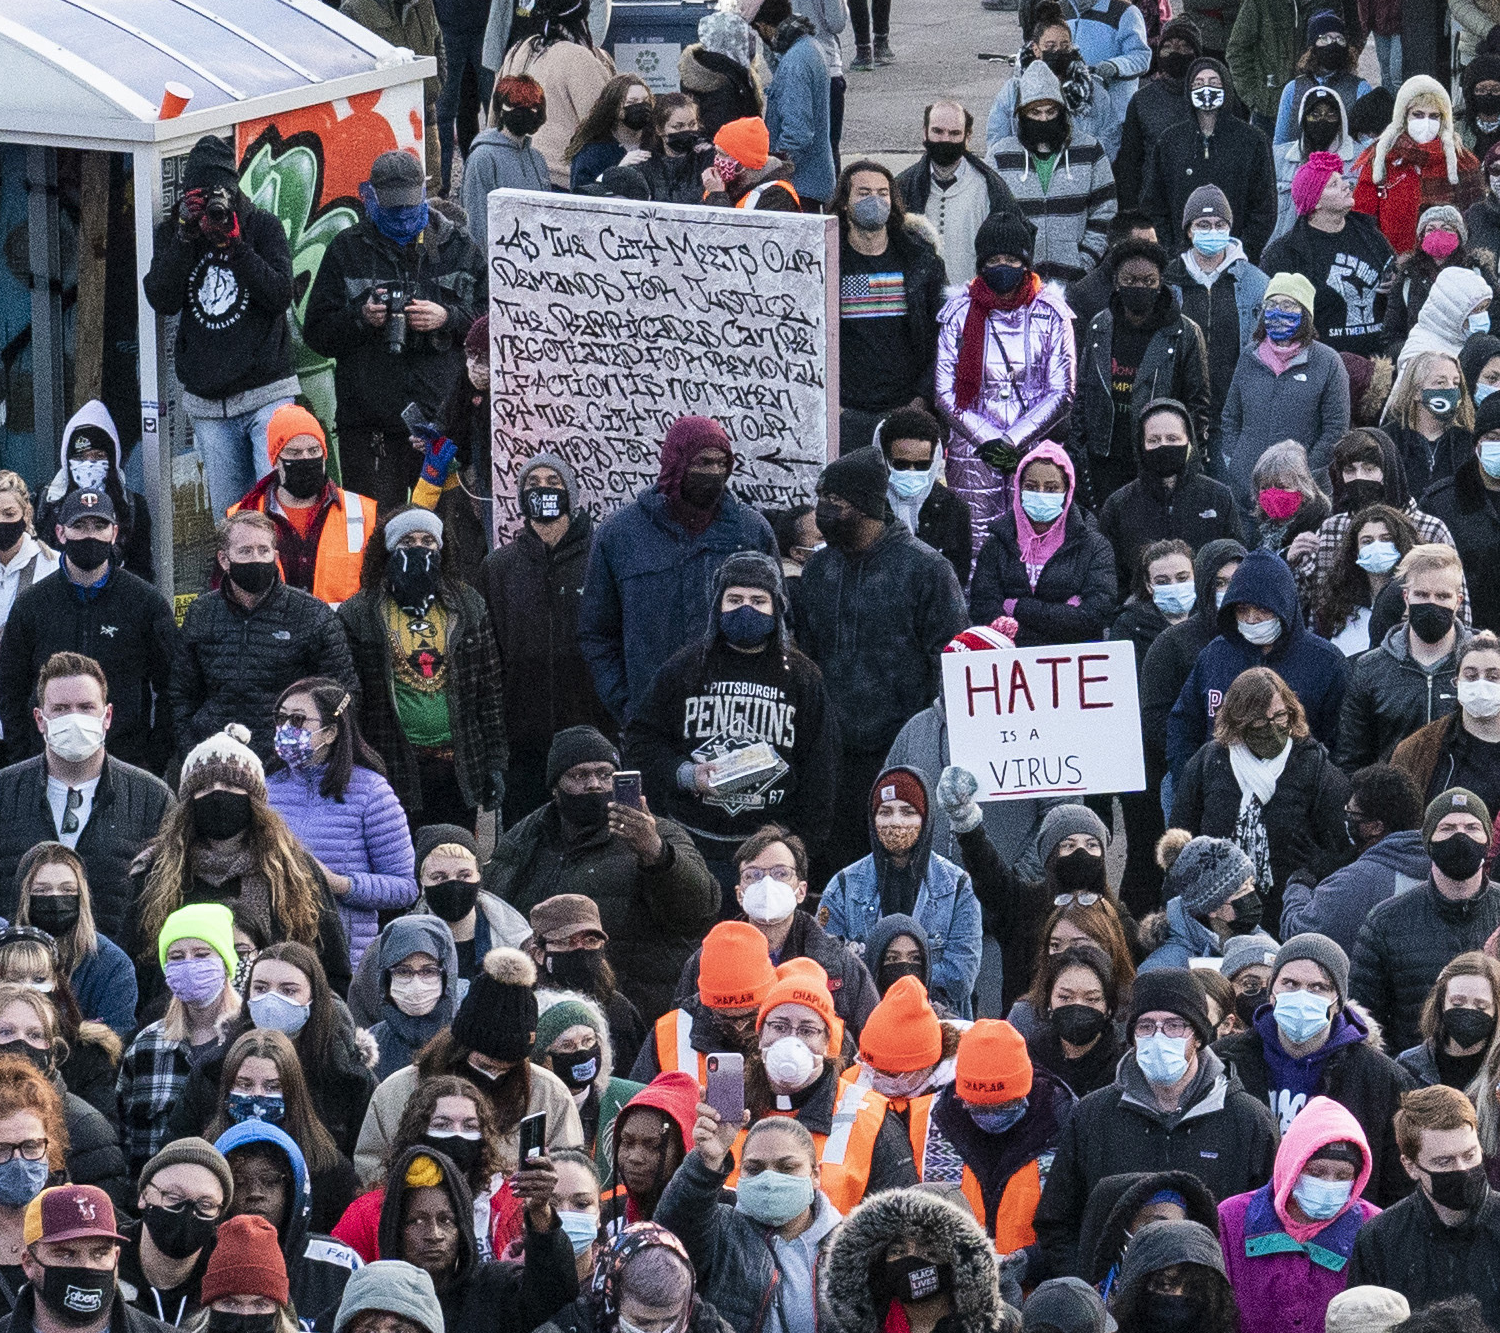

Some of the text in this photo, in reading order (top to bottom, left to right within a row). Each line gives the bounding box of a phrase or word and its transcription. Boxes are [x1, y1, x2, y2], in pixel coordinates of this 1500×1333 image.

[1328, 326, 1344, 338] SAY
[709, 681, 779, 699] PITTSBURGH
[964, 652, 1114, 717] HATE
[683, 698, 795, 747] PENGUINS
[999, 728, 1039, 744] IS A
[988, 754, 1083, 790] VIRUS
[768, 788, 786, 804] 67
[712, 992, 756, 1005] CHAPLAIN
